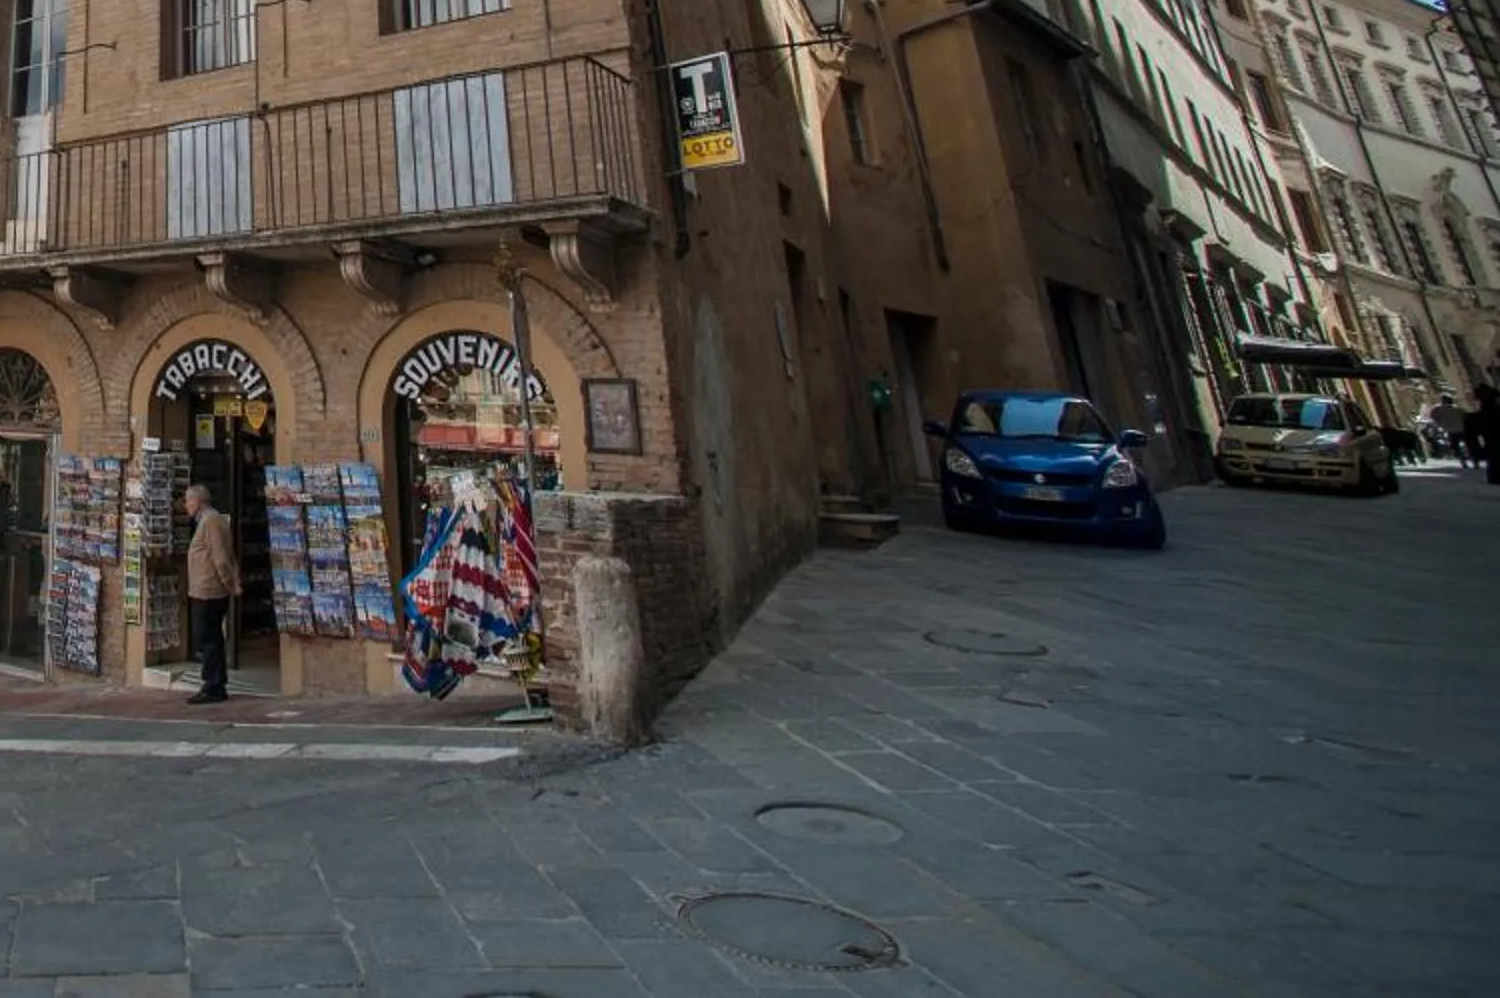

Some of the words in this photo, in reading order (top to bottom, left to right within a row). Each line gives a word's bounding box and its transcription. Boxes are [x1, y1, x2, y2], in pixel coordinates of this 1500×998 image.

[681, 62, 713, 113] T
[683, 137, 733, 155] LOTTO
[156, 344, 267, 401] TABACCHI
